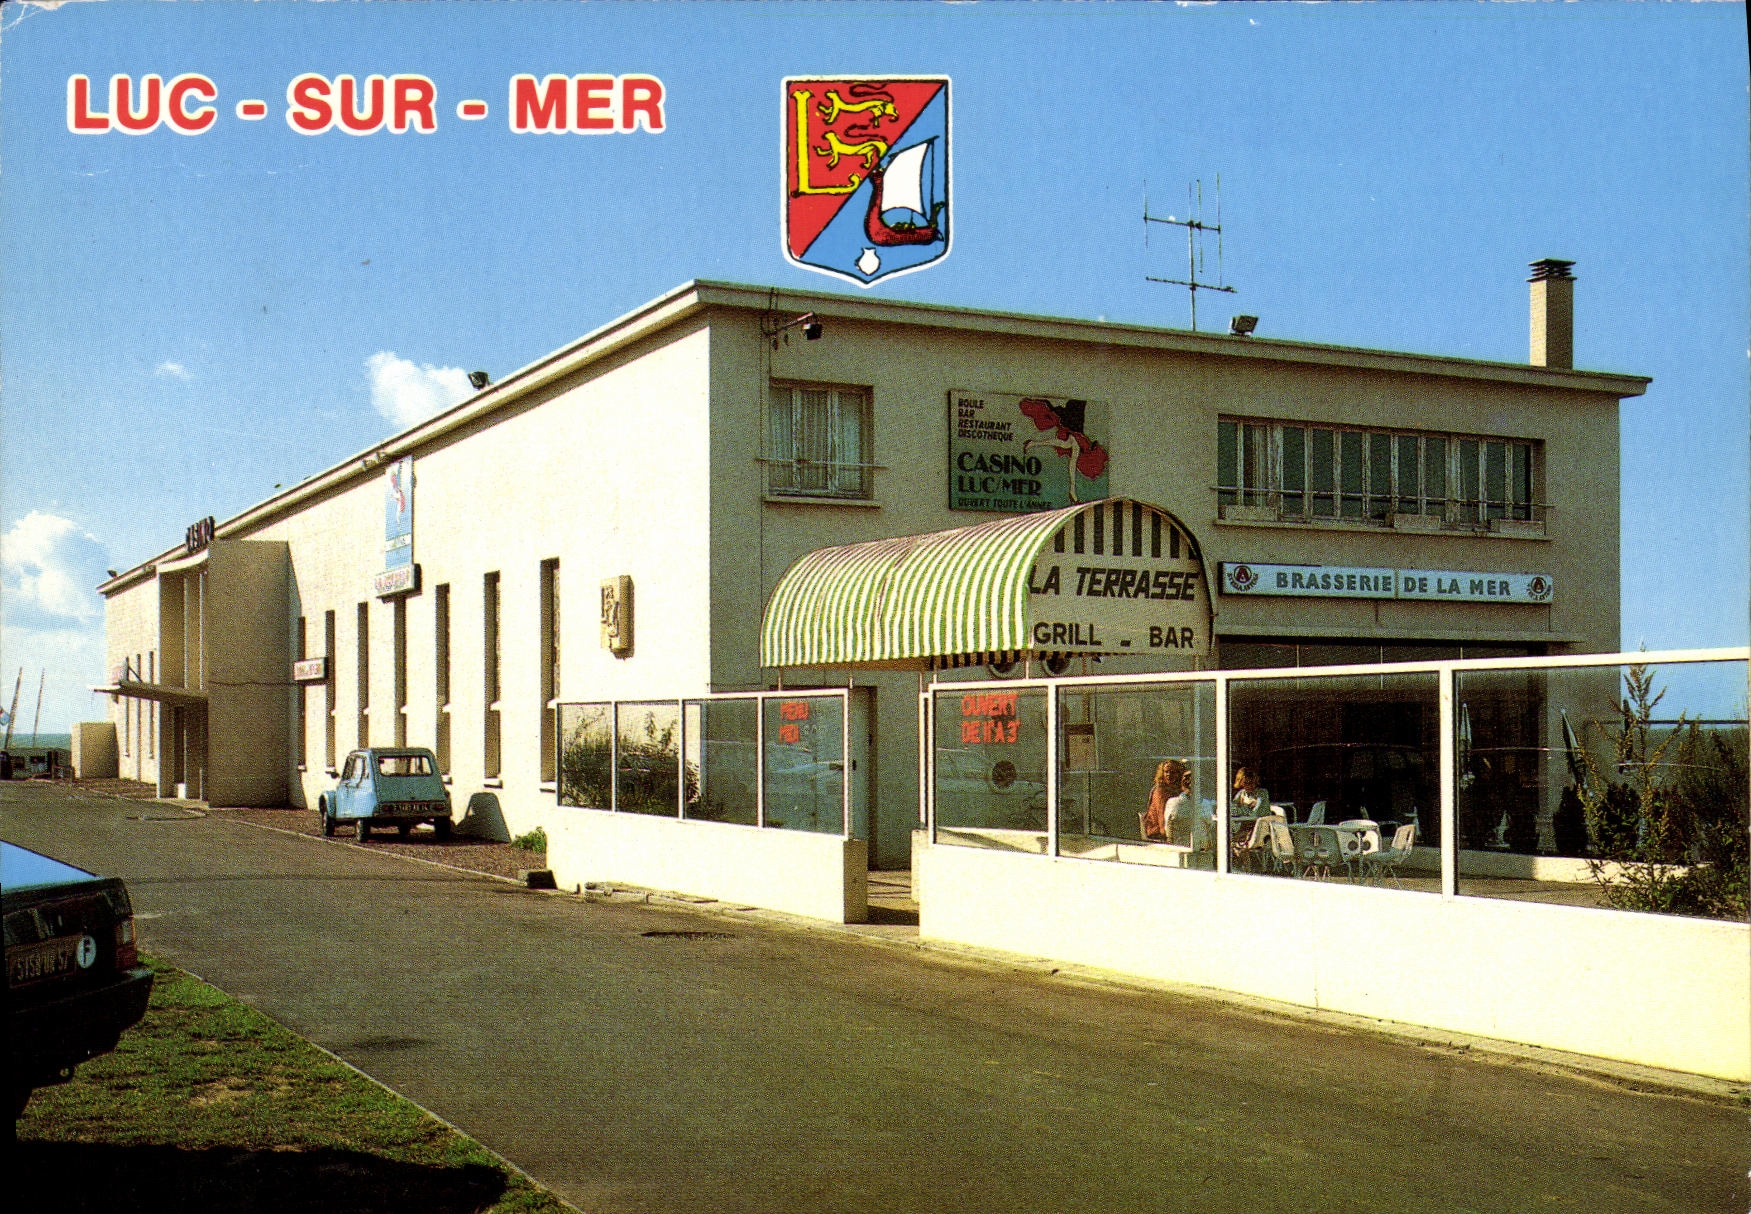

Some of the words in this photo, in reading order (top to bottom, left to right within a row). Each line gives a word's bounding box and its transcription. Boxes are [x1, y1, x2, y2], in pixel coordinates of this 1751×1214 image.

[958, 399, 985, 409] BOULE
[958, 410, 975, 419] BAR
[958, 420, 1012, 431] RESTAURANT
[958, 431, 1013, 443] DISCOTHEQUE
[957, 452, 1043, 475] CASINO
[1029, 564, 1061, 595] LA
[1076, 566, 1200, 601] TERRASSE
[1275, 571, 1393, 592] BRASSERIE
[1403, 576, 1428, 594] DE
[1437, 578, 1461, 596] LA
[1470, 579, 1512, 597] MER
[1033, 621, 1102, 646] GRILL
[1149, 625, 1195, 649] BAR
[961, 693, 1018, 717] OUVERT
[961, 719, 981, 744] DE
